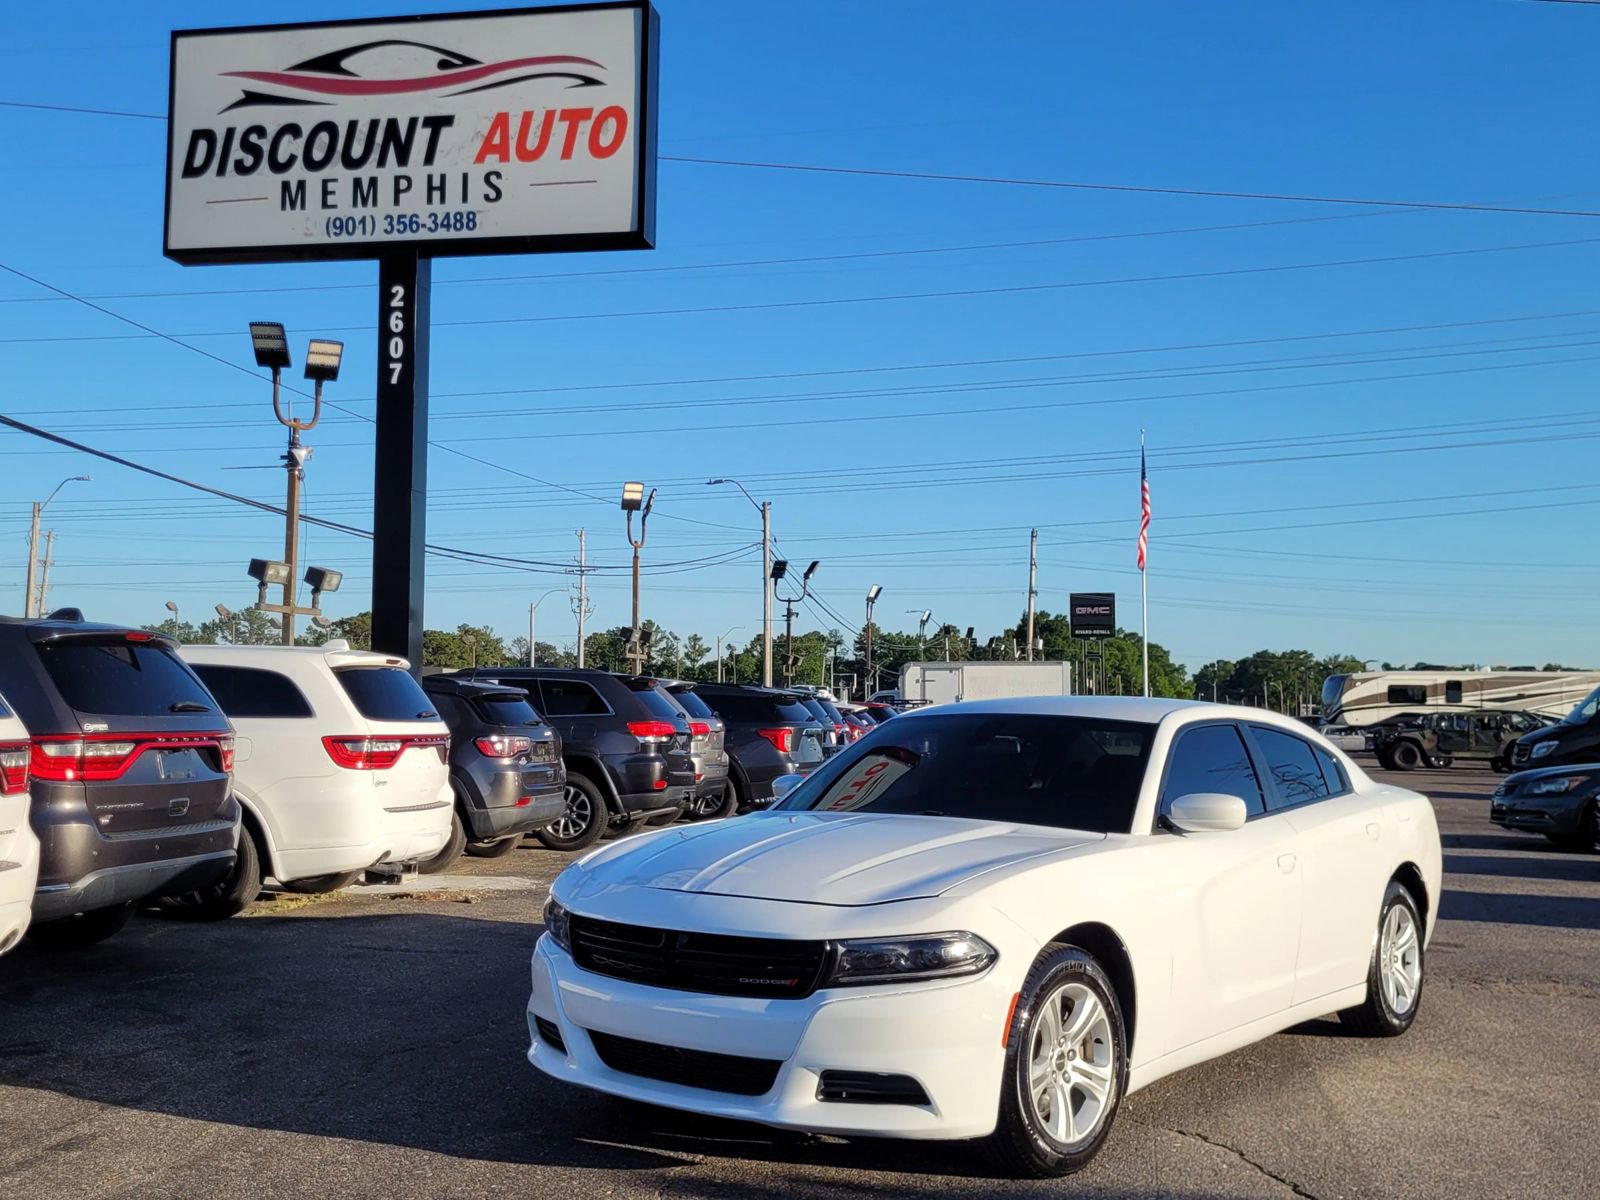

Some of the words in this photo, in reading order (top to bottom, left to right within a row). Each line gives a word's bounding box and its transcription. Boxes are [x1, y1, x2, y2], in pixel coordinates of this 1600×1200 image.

[182, 114, 455, 178] DISCOUNT
[473, 105, 628, 164] AUTO
[281, 171, 503, 211] MEMPHIS
[325, 214, 376, 238] (901)
[384, 211, 477, 235] 356-3488
[389, 285, 405, 384] 2607
[1075, 606, 1110, 614] GMC
[739, 977, 791, 985] DODGE
